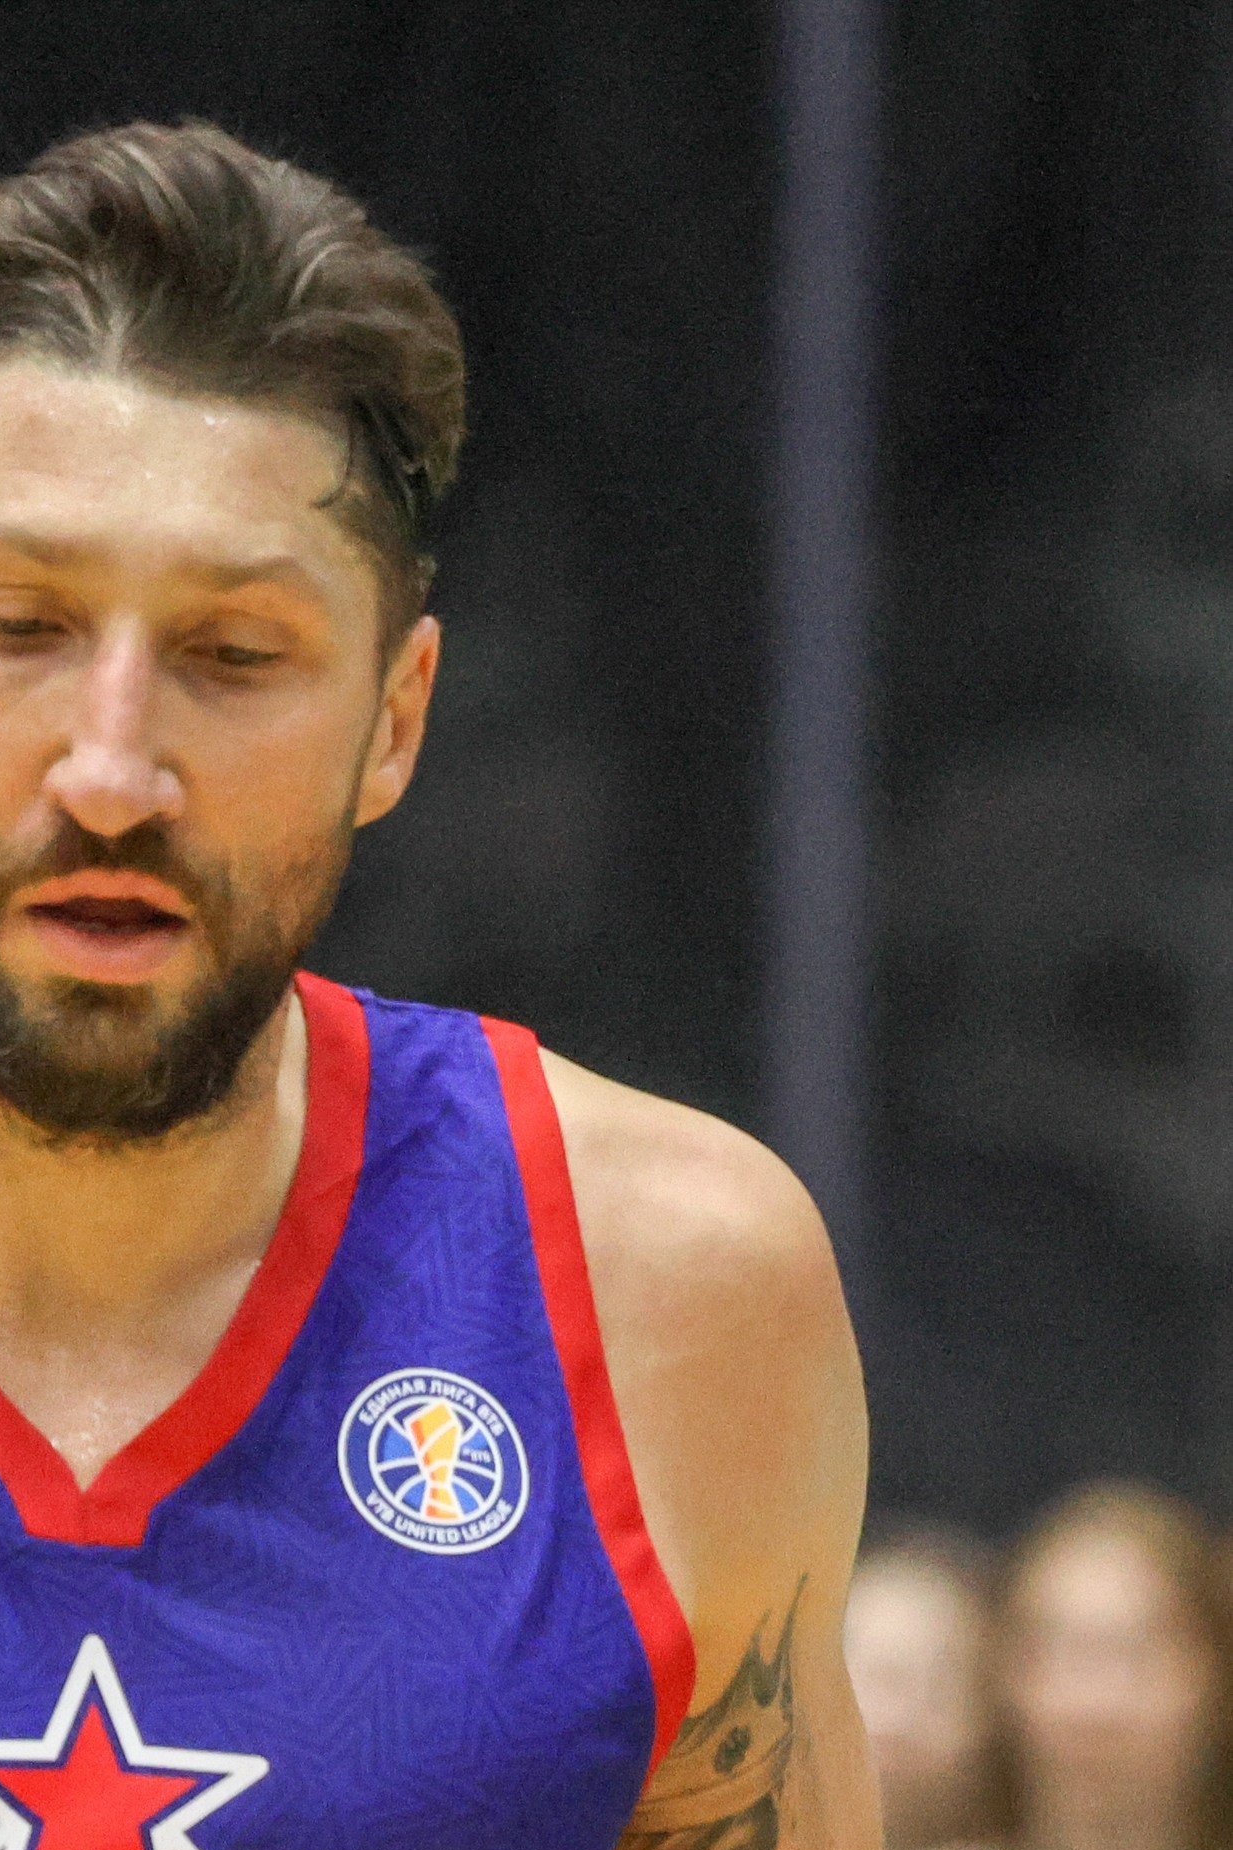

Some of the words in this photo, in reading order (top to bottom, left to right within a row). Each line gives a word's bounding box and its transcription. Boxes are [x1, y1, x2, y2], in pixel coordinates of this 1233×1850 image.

[359, 1378, 426, 1425] ЕДИНАЯ
[430, 1379, 476, 1410] ЛИГА
[366, 1489, 395, 1523] VTB
[394, 1519, 460, 1544] UNITED
